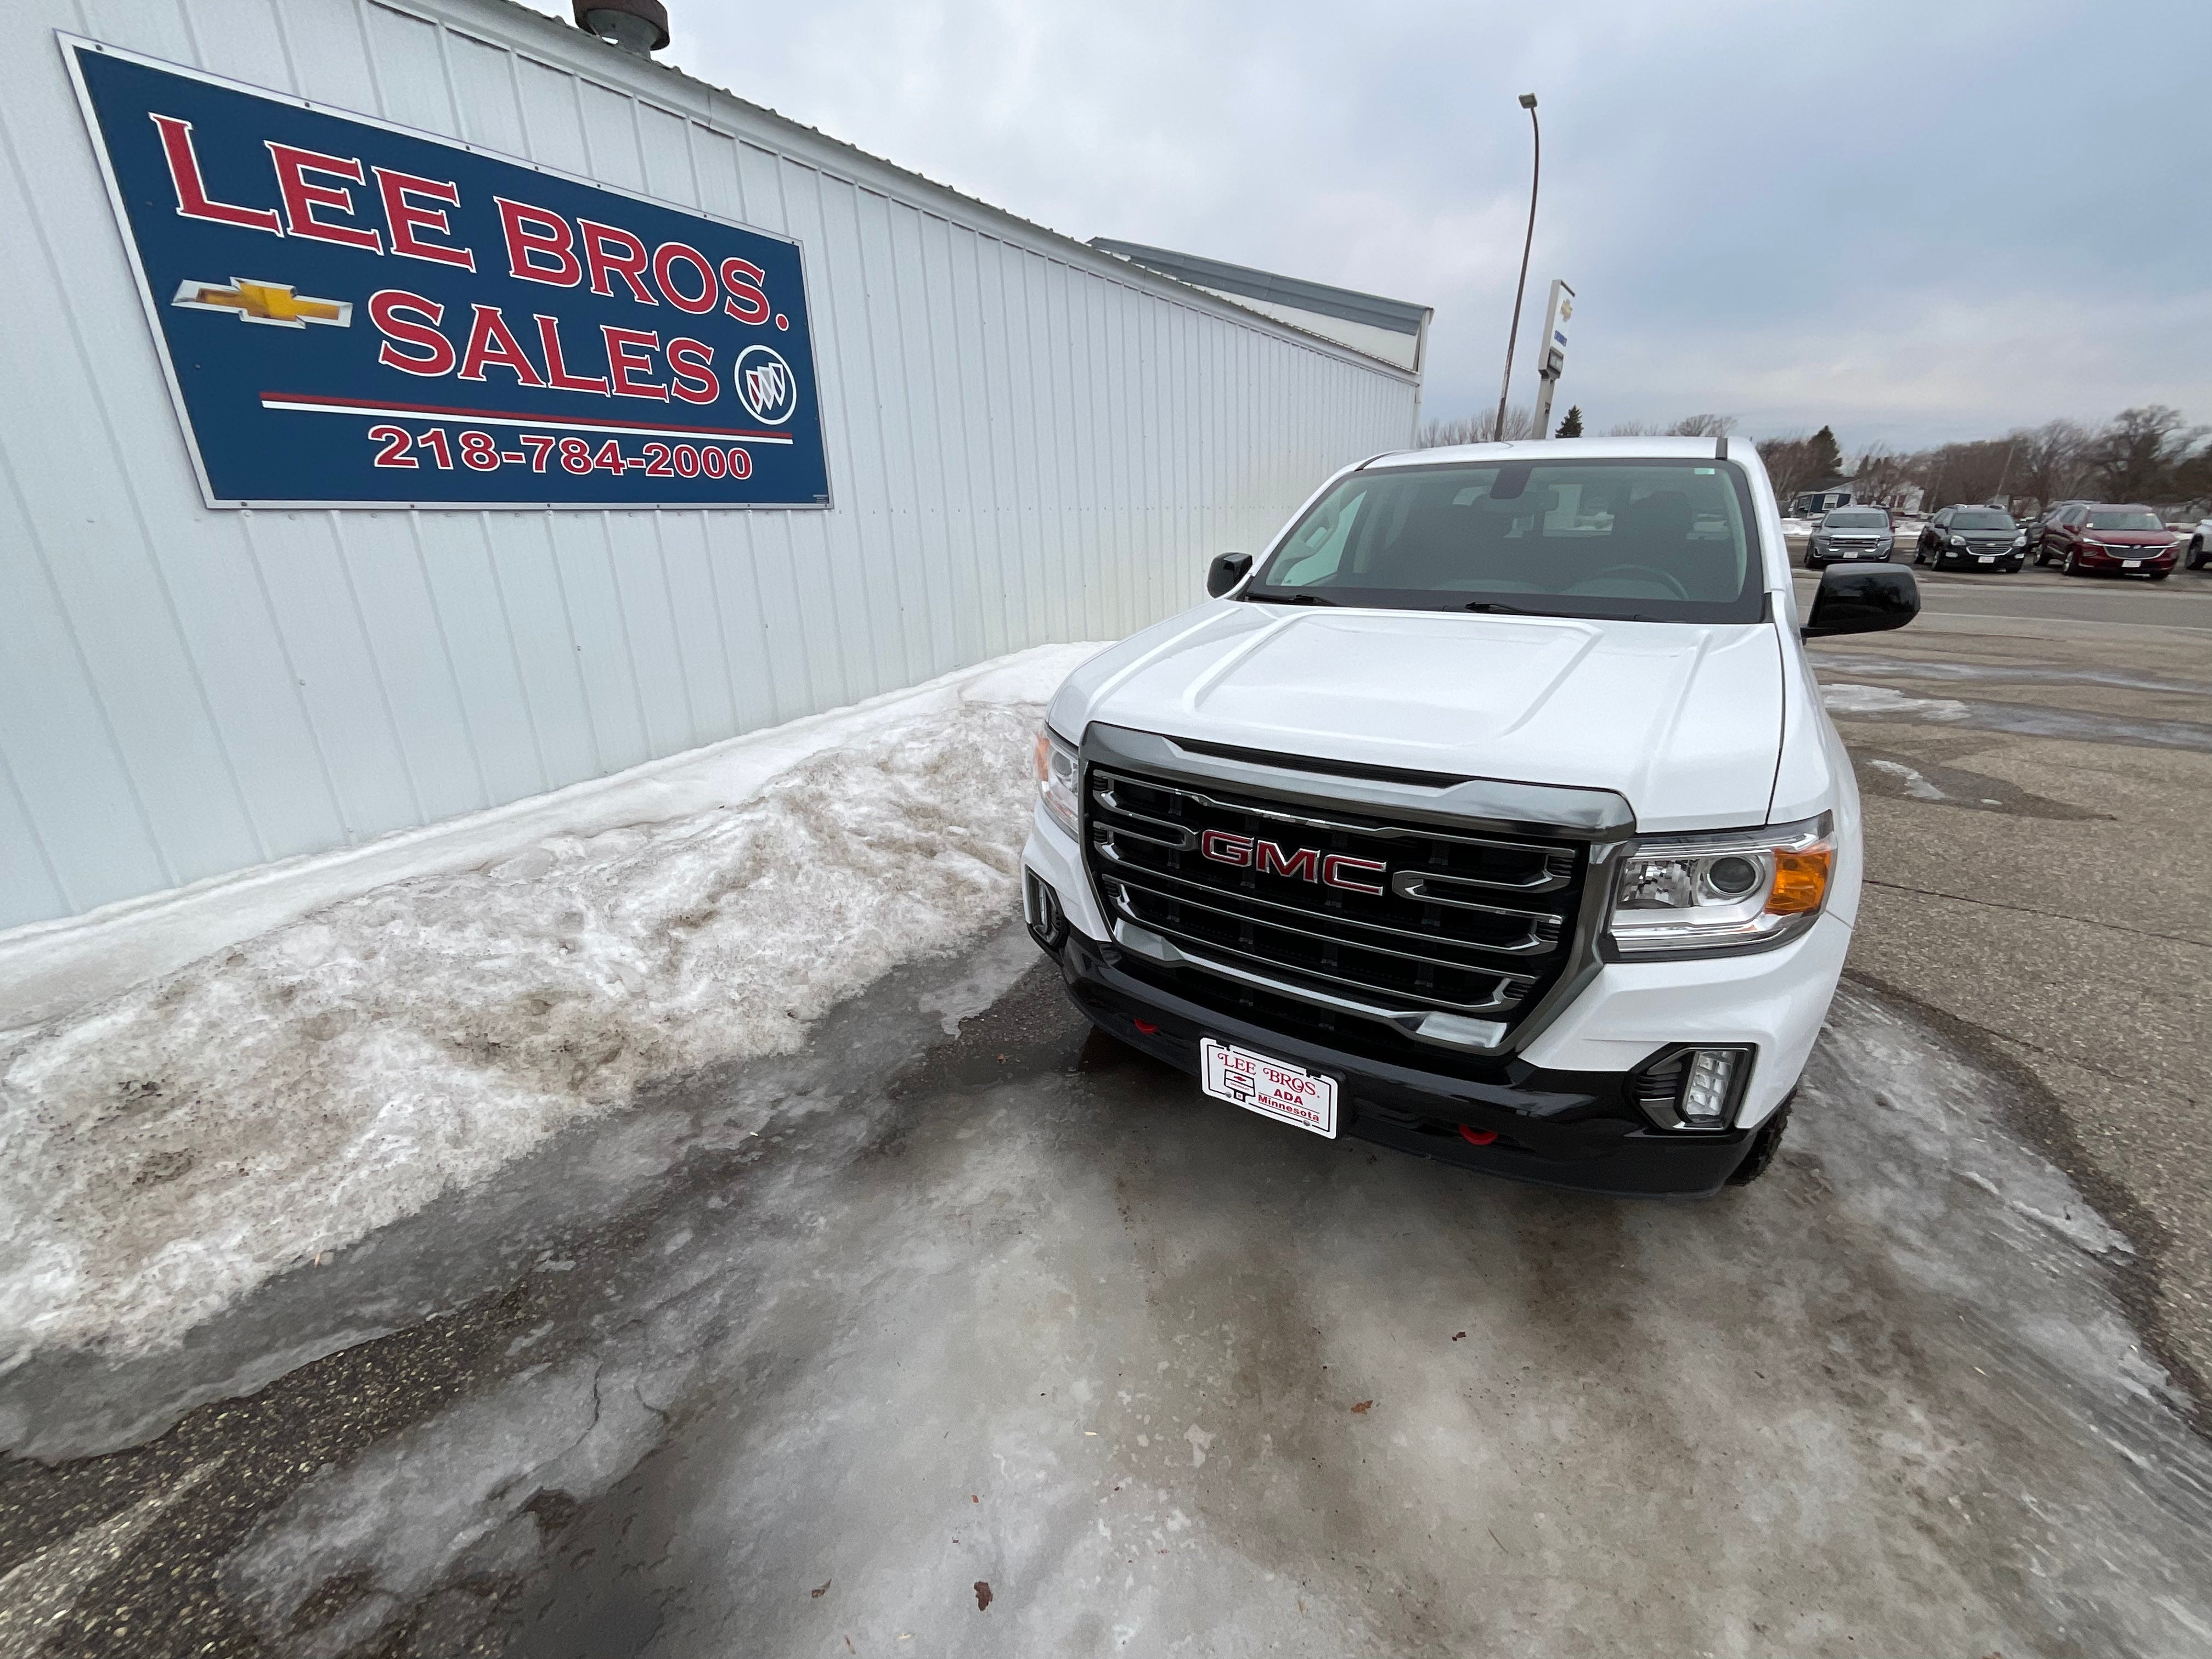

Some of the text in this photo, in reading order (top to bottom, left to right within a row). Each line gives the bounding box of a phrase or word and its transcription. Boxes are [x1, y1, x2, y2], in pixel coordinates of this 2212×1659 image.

[148, 111, 789, 331] LEE BROS.
[368, 289, 721, 405] SALES
[368, 425, 753, 479] 218-784-2000
[1201, 829, 1387, 896] GMC
[1217, 1052, 1321, 1098] LEE BROS.
[1274, 1088, 1304, 1105] ADA
[1258, 1094, 1319, 1121] Minnesota
